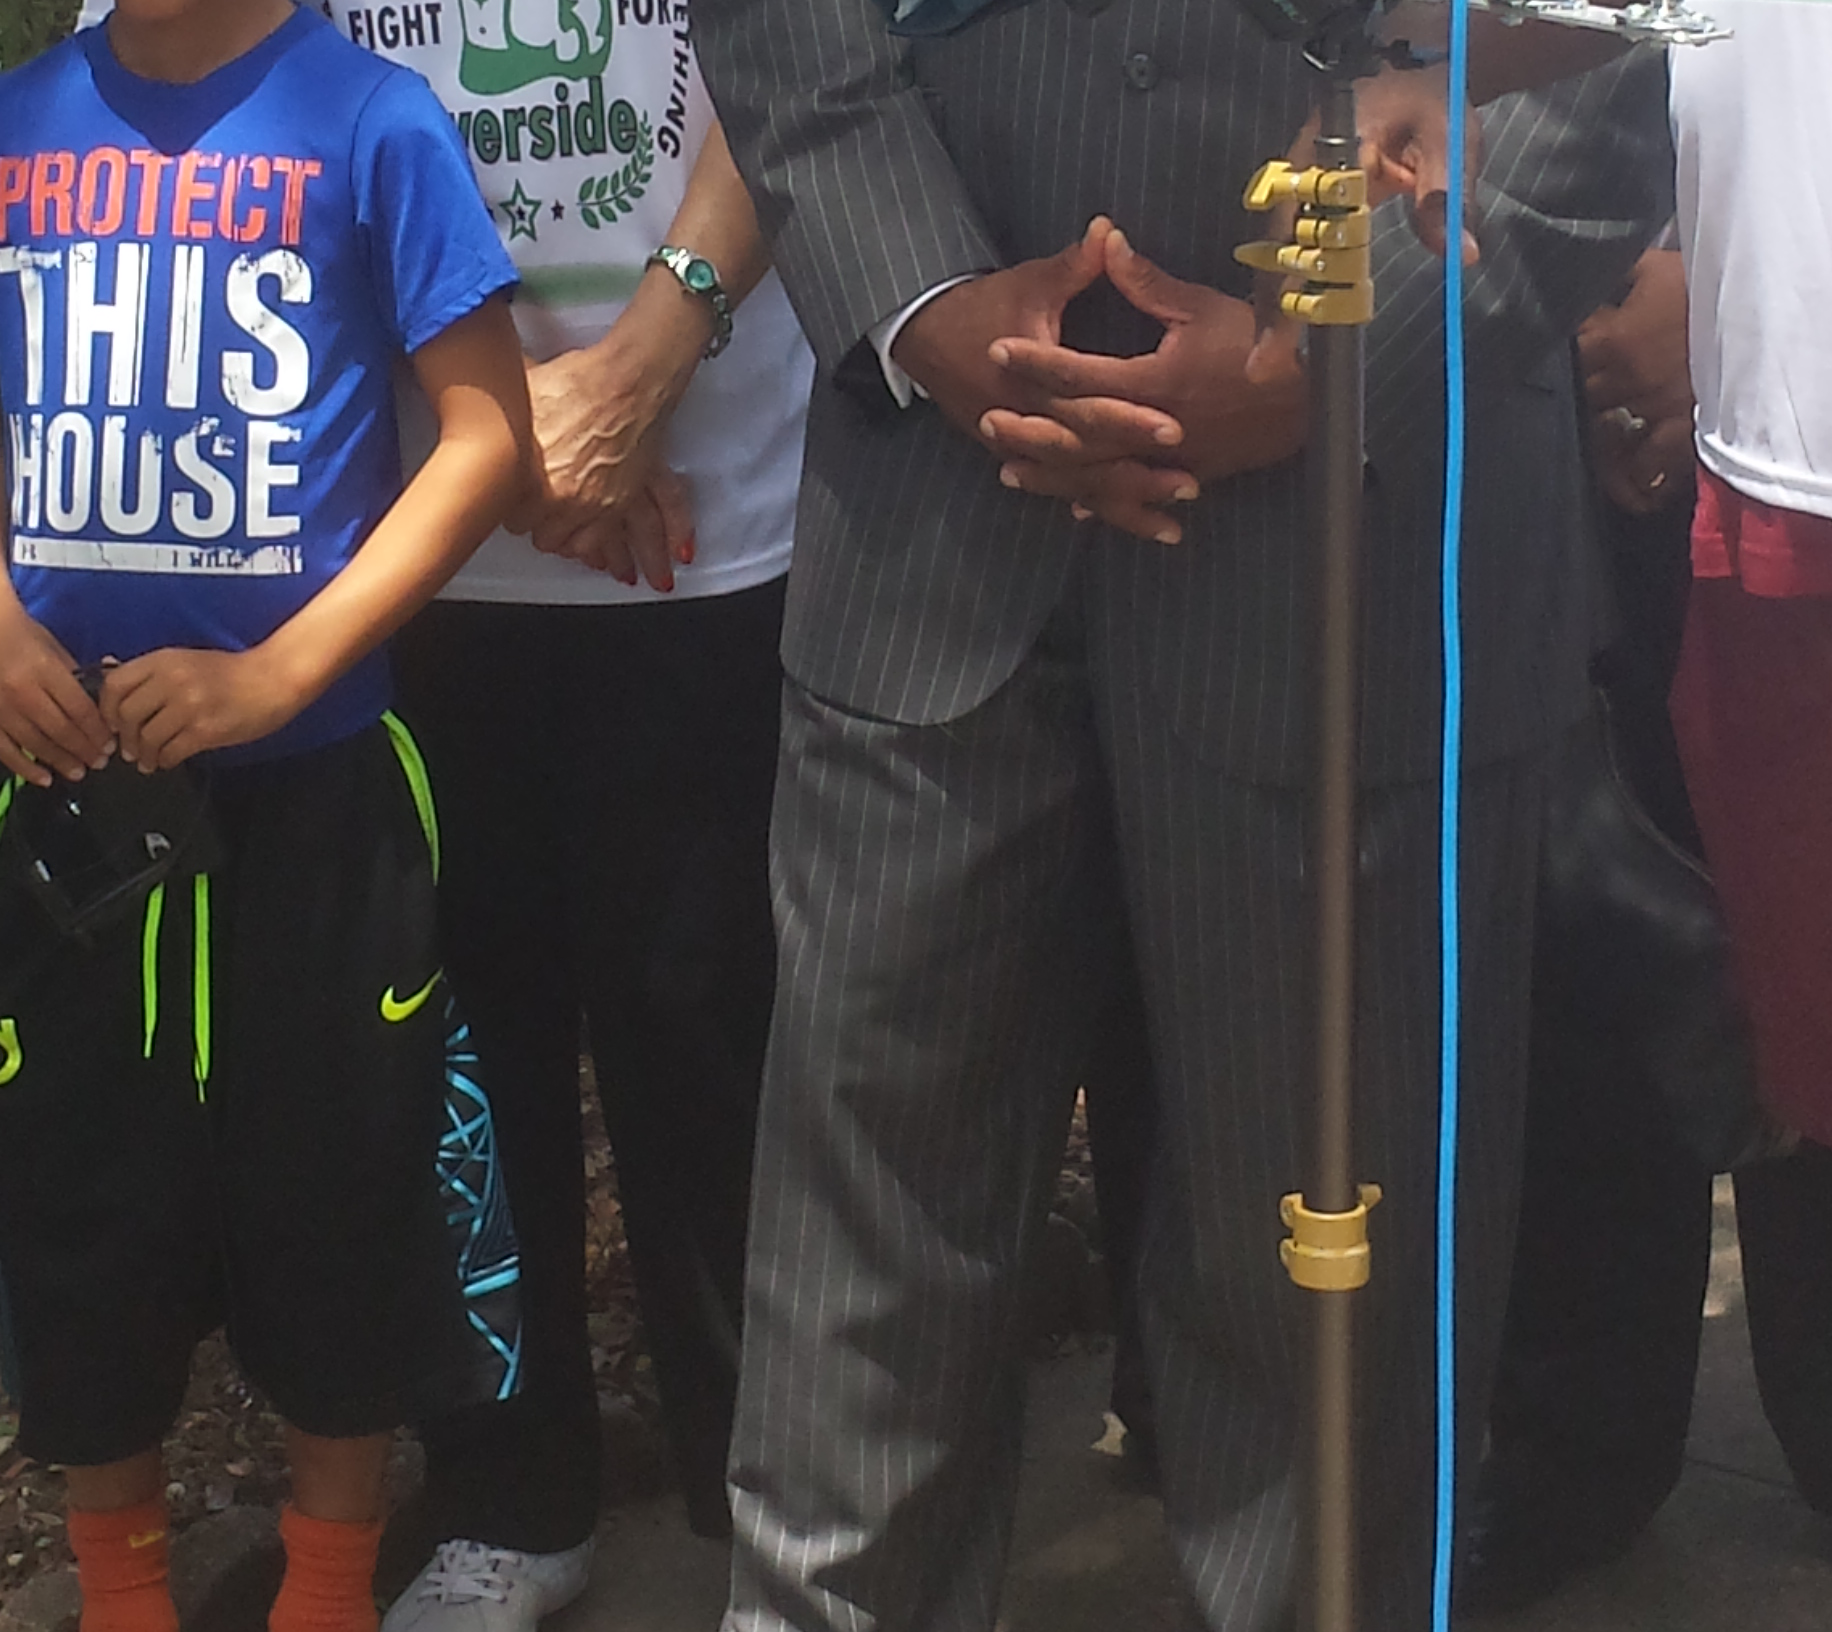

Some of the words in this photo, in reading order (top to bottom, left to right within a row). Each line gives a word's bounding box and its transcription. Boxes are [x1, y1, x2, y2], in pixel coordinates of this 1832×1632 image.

[348, 2, 442, 50] FIGHT
[0, 146, 322, 245] PROTECT
[0, 241, 313, 418] THIS
[10, 411, 302, 539] HOUSE
